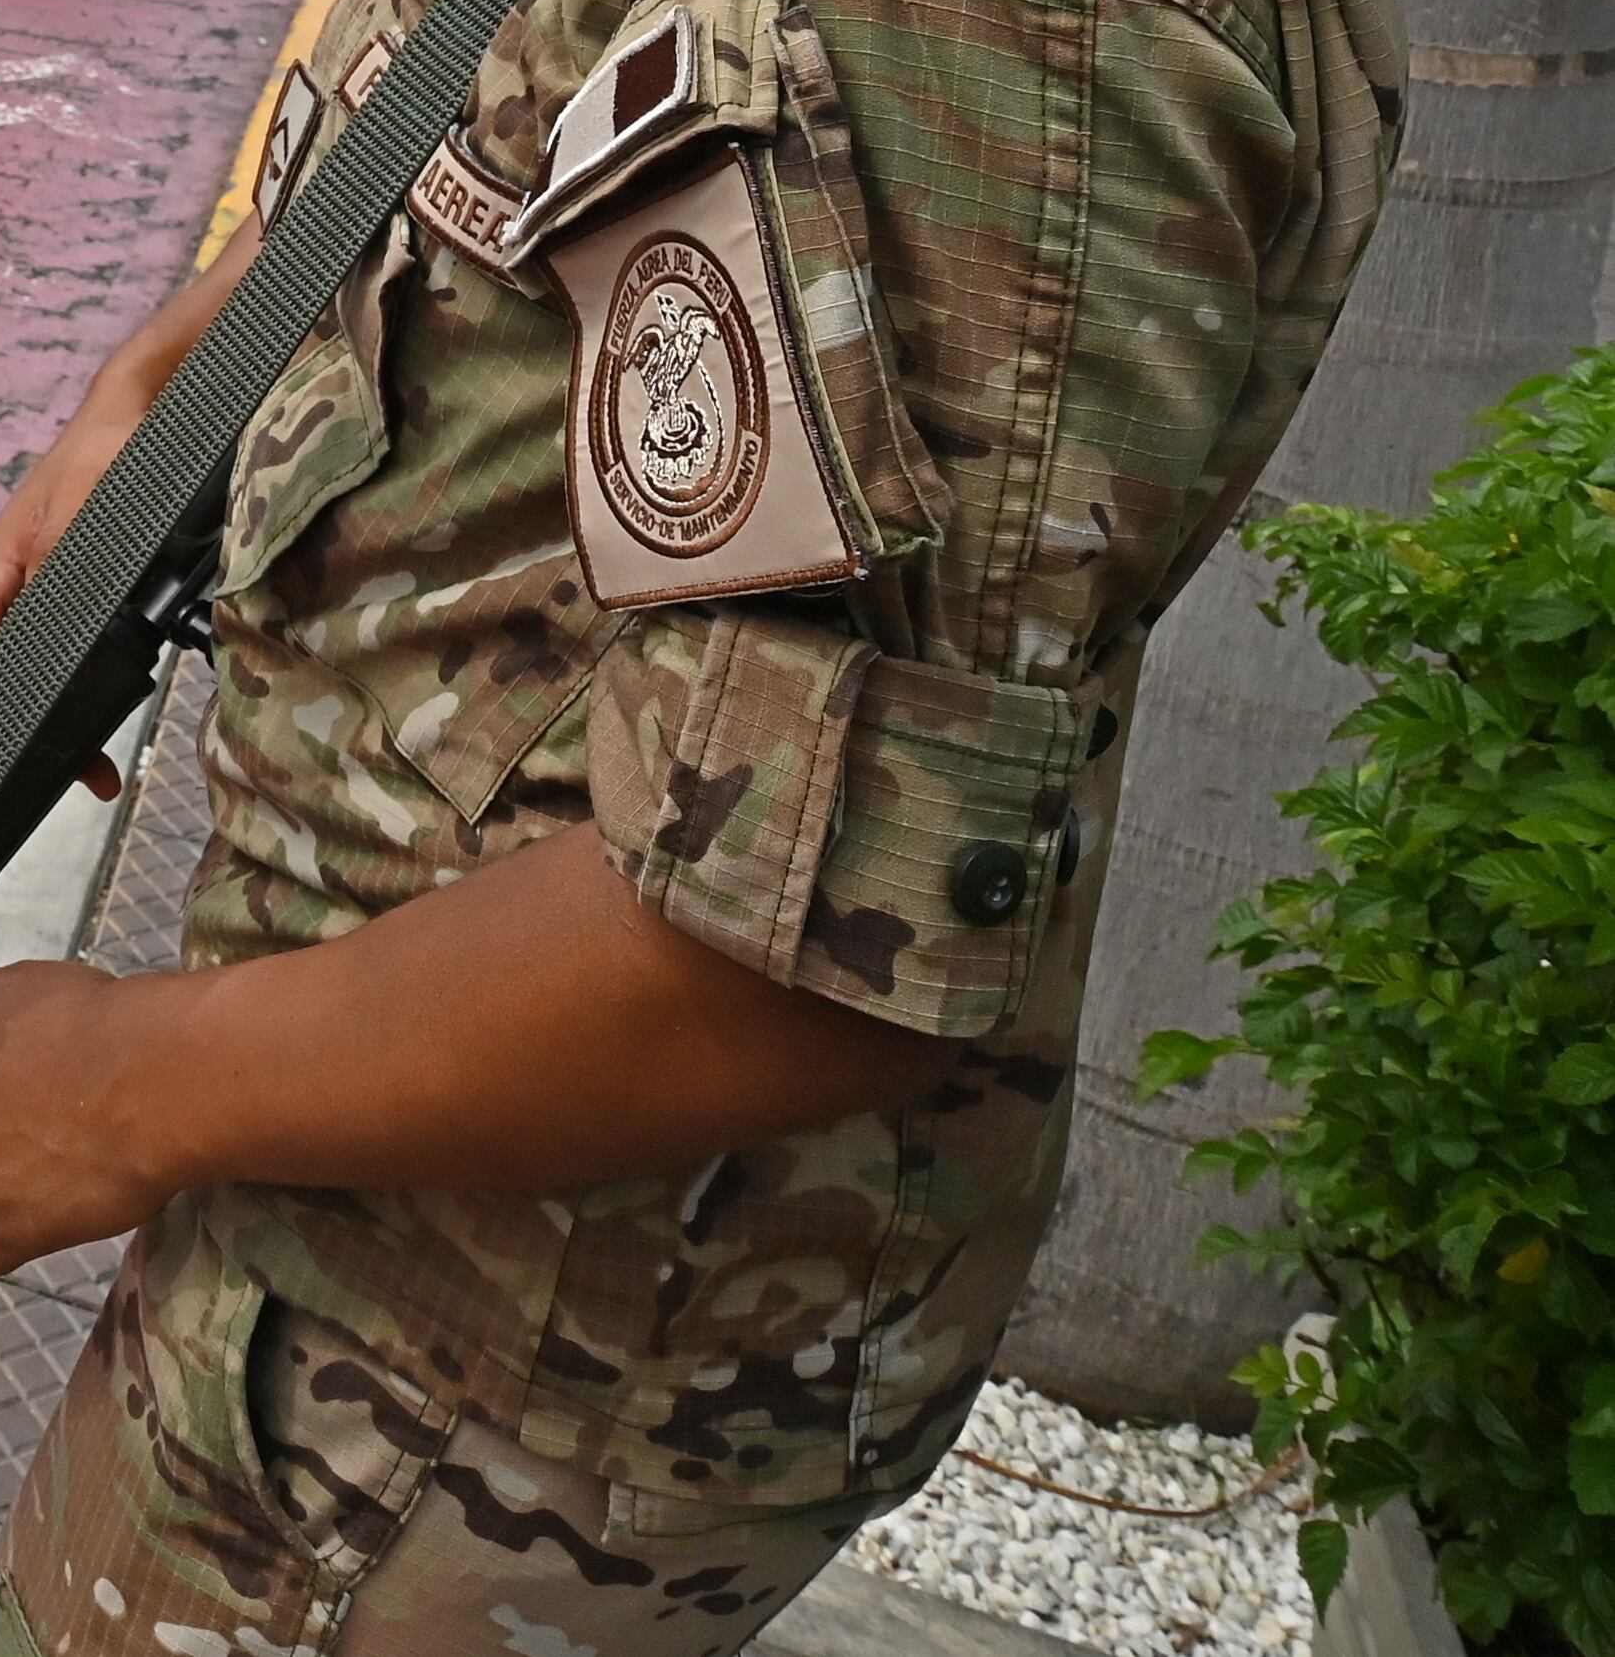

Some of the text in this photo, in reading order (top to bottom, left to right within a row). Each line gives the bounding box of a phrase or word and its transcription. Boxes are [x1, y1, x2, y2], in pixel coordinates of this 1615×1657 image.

[420, 158, 512, 254] AEREA
[610, 246, 731, 349] FUERZA AEREA DEL PERU
[609, 439, 759, 541] SERVICIO DE MANTENIMIENTO
